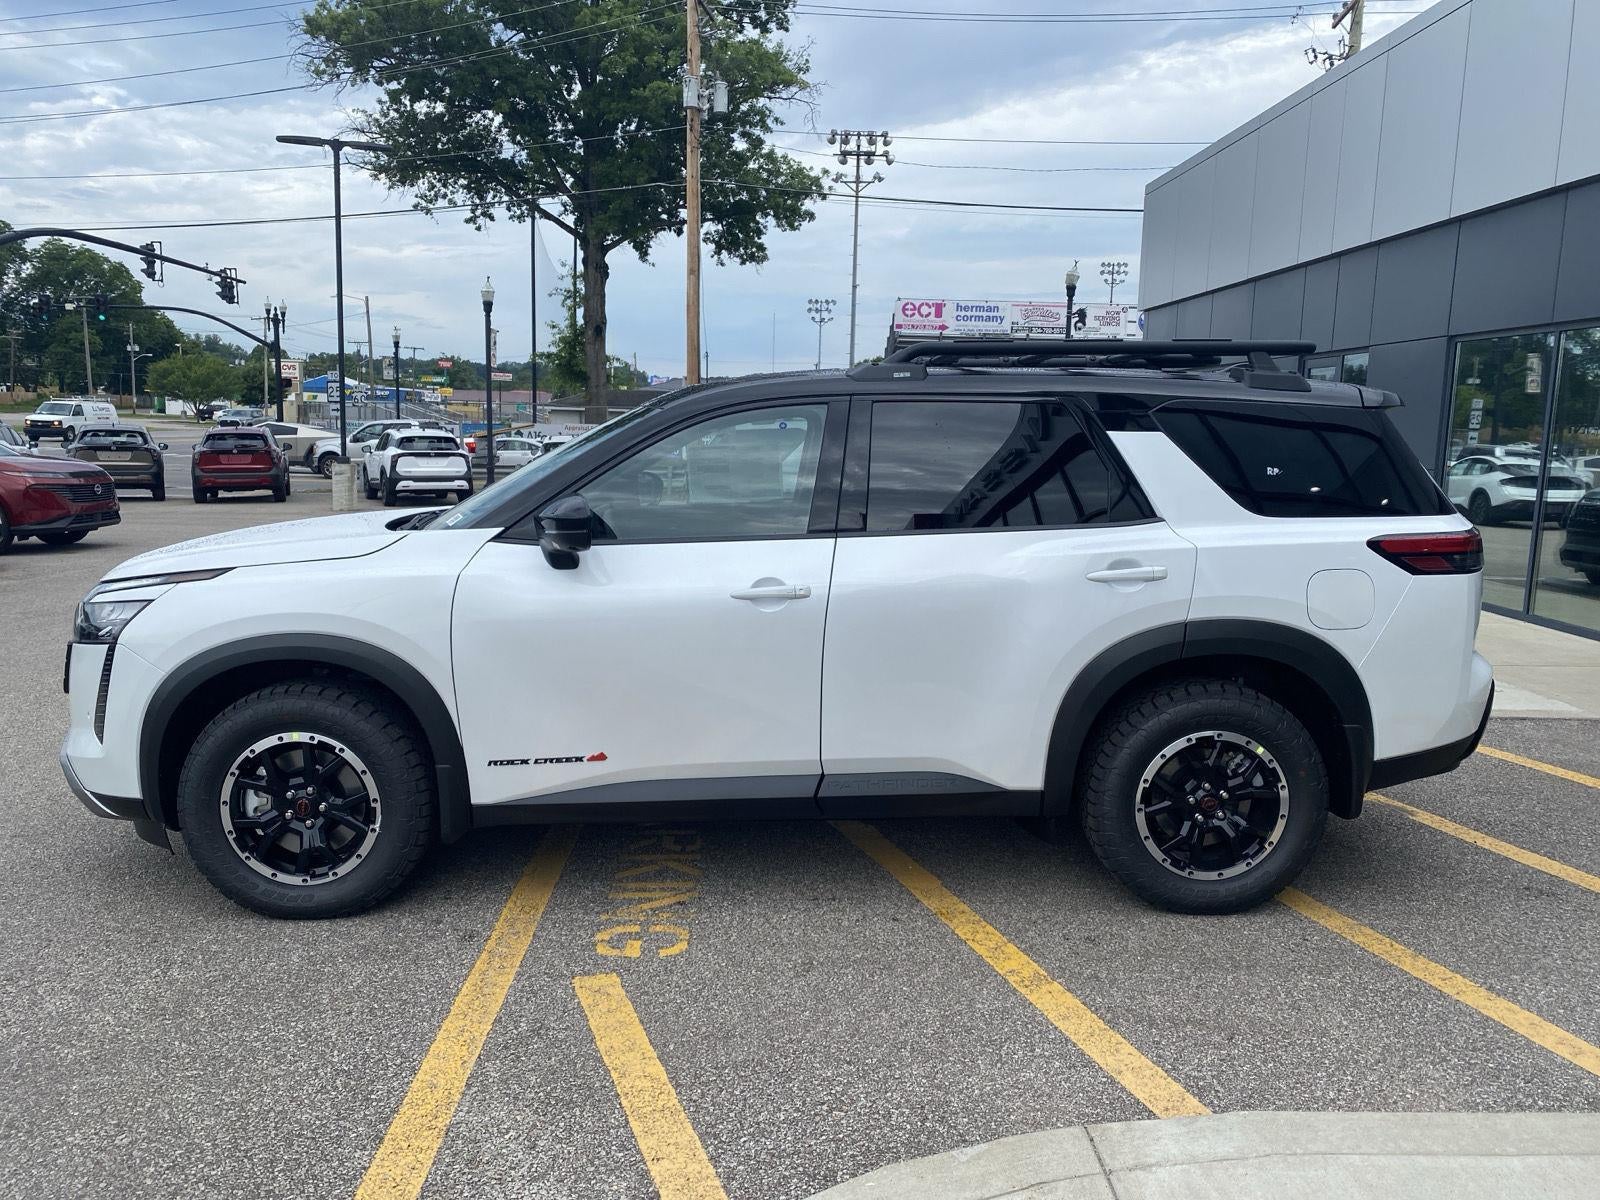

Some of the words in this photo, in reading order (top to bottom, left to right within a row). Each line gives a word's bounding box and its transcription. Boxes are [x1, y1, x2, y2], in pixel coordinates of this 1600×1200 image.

[955, 302, 1000, 313] herman
[955, 314, 1005, 325] cormany
[487, 758, 532, 767] ROCK
[533, 755, 586, 765] CREEK
